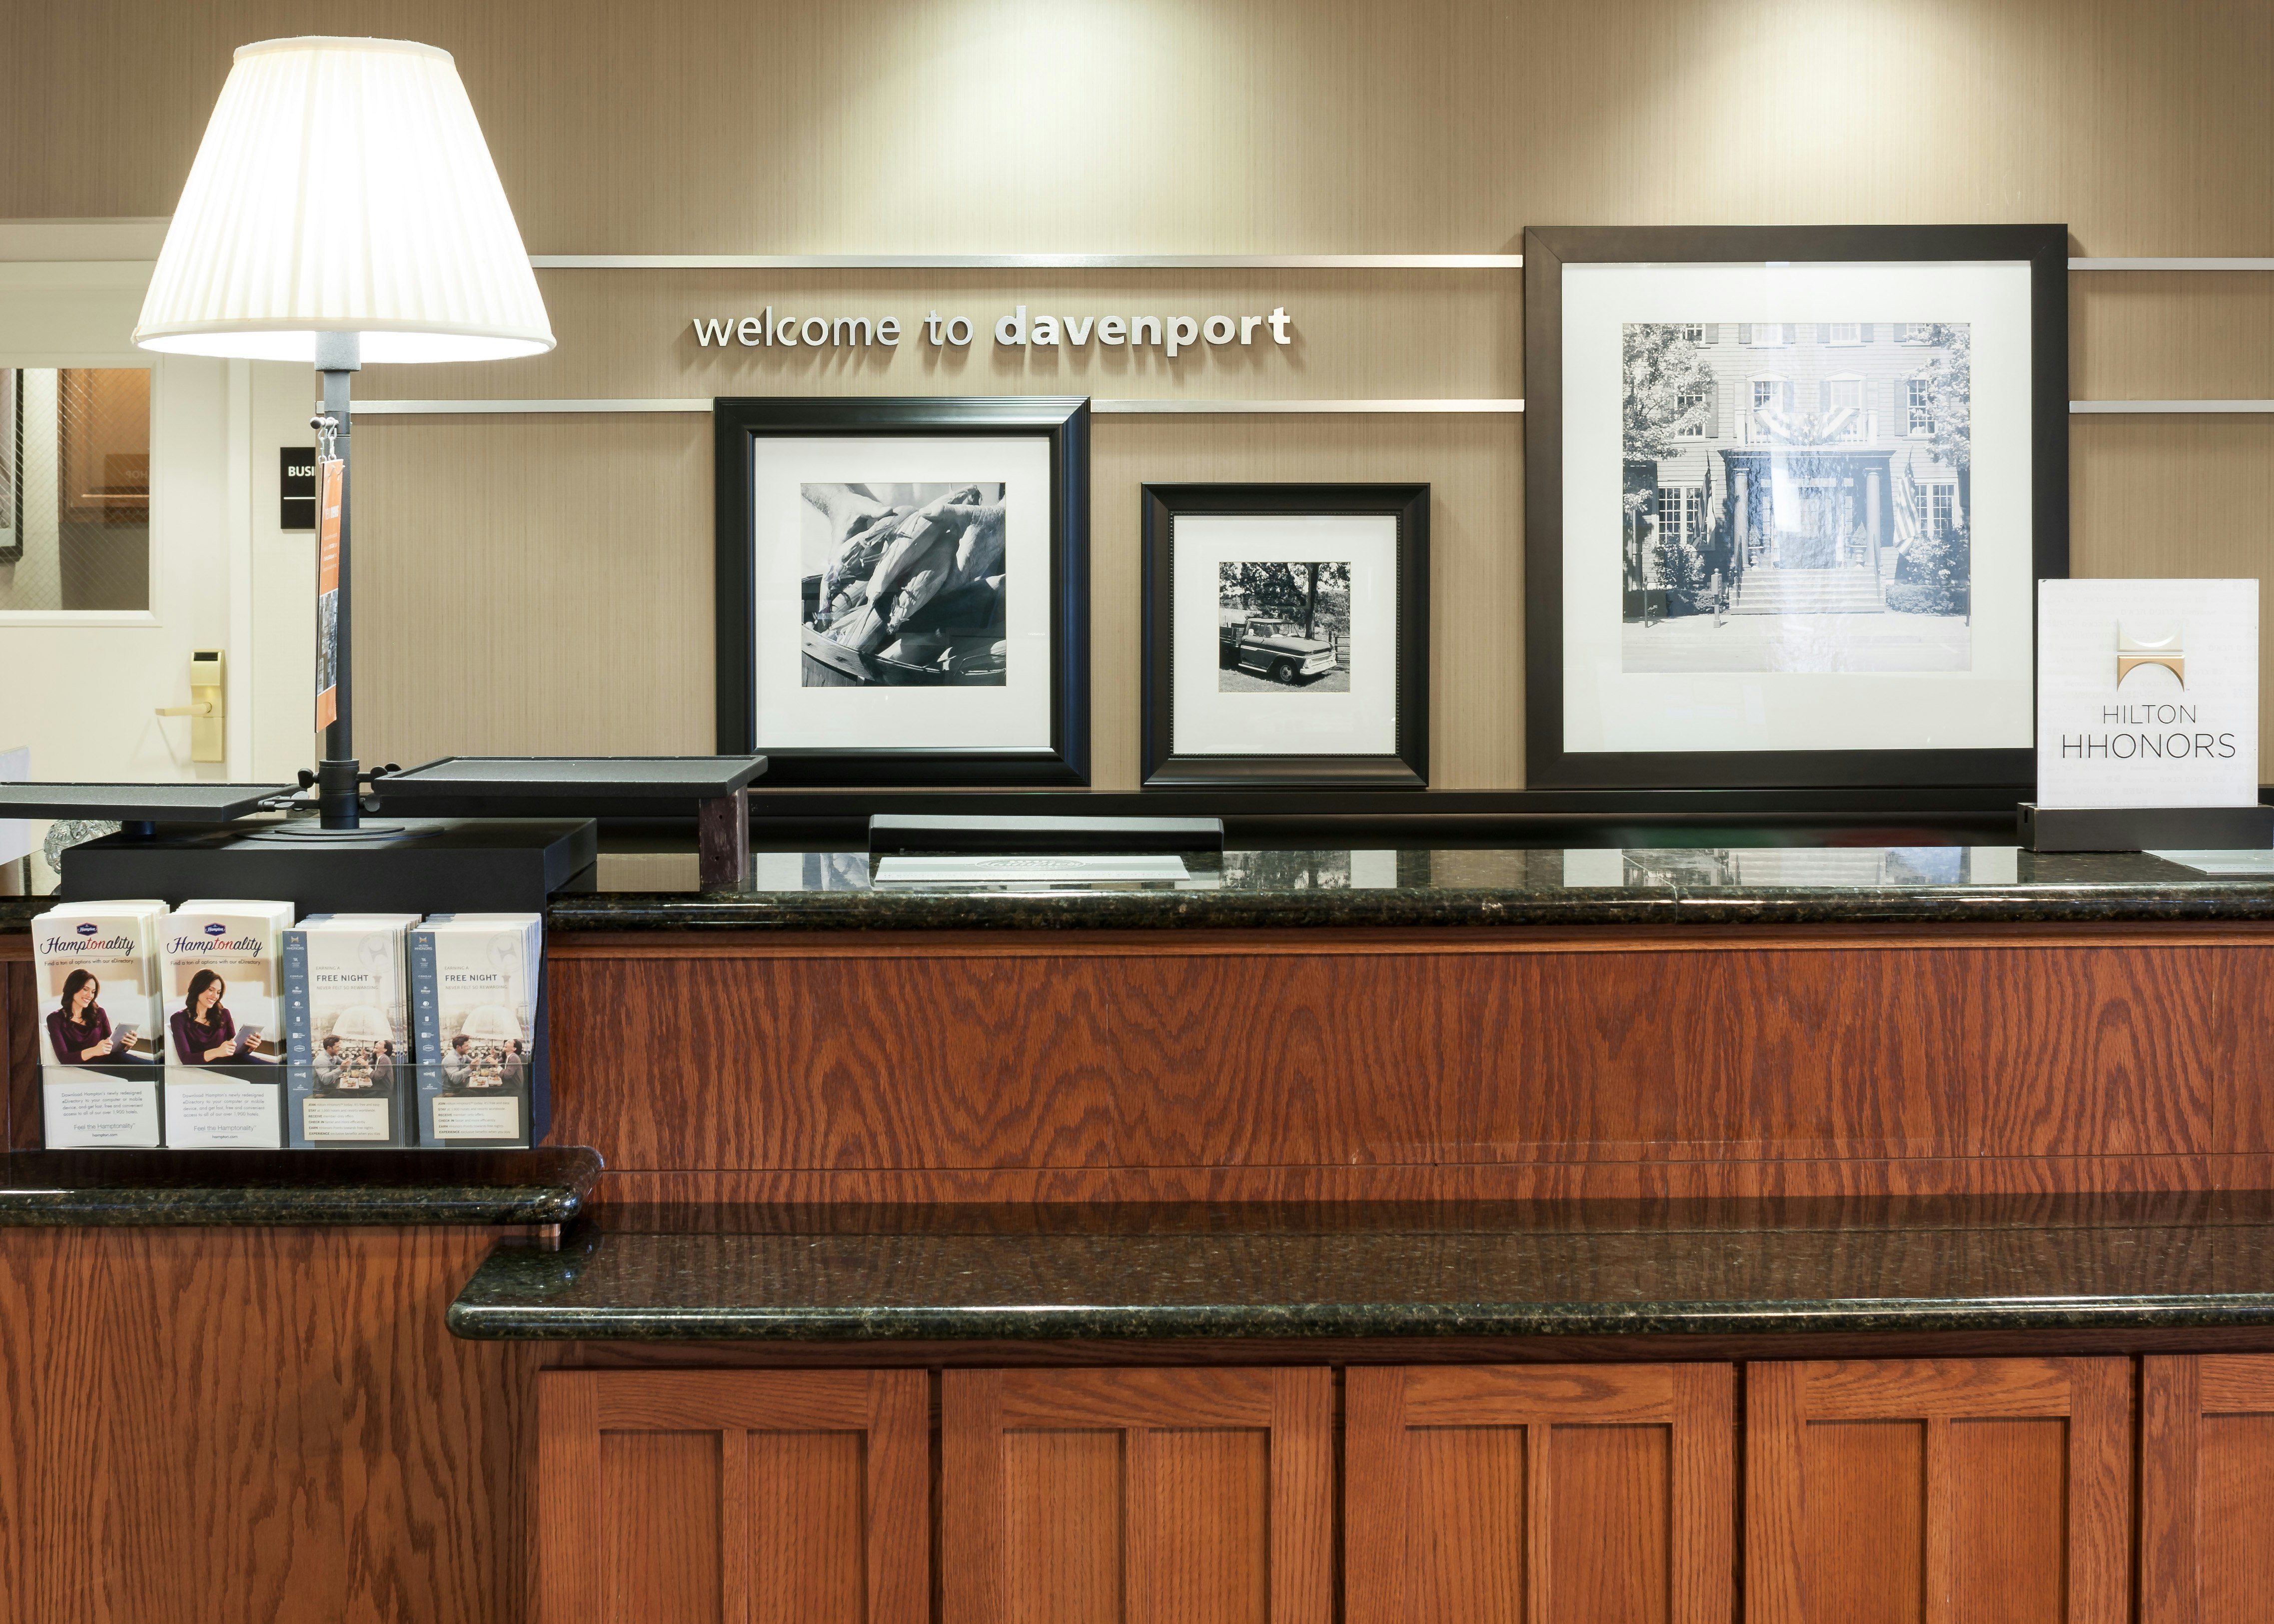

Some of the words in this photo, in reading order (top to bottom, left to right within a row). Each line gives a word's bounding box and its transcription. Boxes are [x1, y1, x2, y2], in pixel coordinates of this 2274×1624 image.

[693, 306, 900, 347] welcome
[923, 309, 974, 346] to
[995, 305, 1291, 357] davenport
[288, 466, 316, 477] BUSI
[2104, 705, 2196, 724] HILTON
[2063, 733, 2236, 759] HHONORS
[40, 935, 135, 956] Hamptonality
[166, 936, 263, 958] Hamptonality
